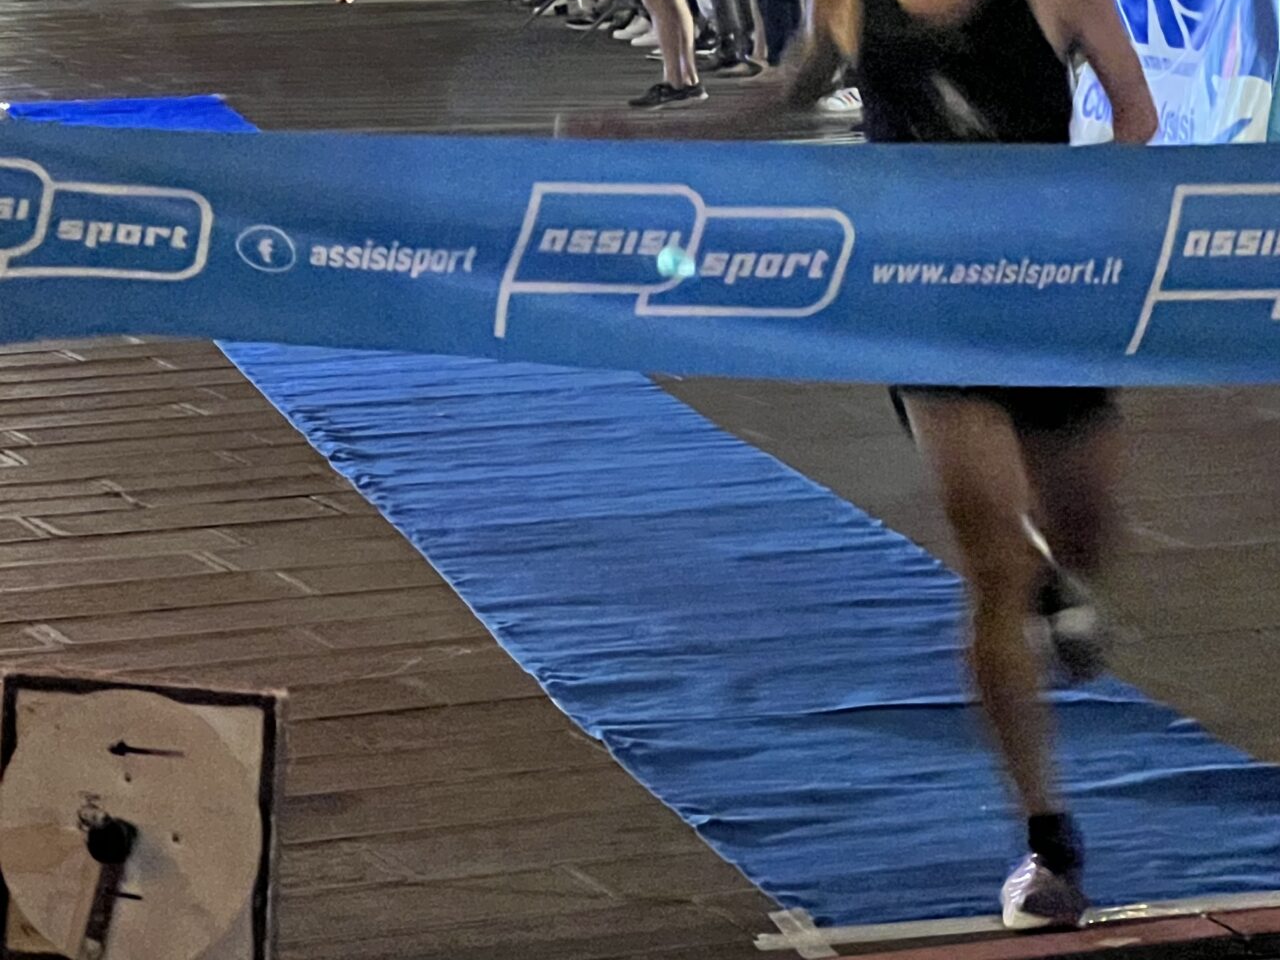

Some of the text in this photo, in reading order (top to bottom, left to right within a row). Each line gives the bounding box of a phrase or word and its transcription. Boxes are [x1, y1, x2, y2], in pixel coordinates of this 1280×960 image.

[57, 217, 189, 249] sport
[309, 240, 478, 279] assisisport
[700, 249, 830, 285] sport
[872, 257, 1124, 290] www.assisisport.it
